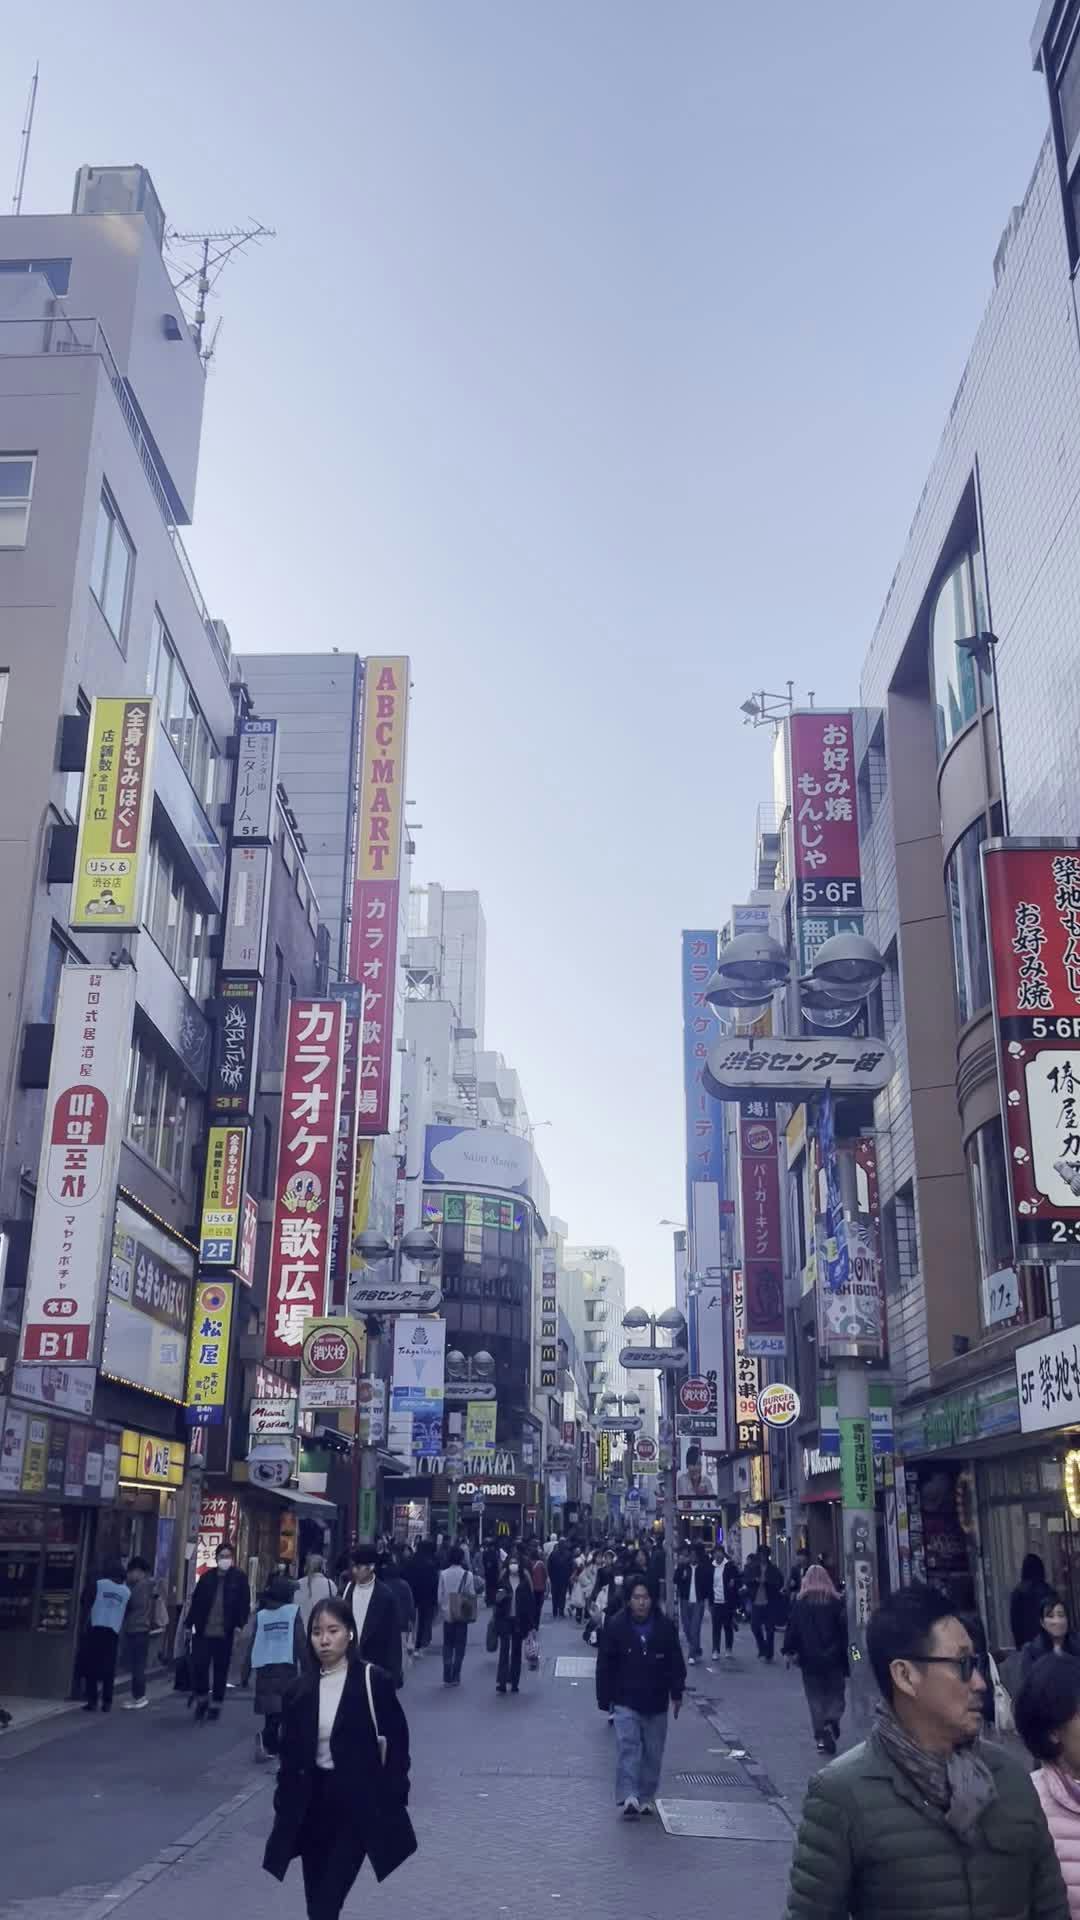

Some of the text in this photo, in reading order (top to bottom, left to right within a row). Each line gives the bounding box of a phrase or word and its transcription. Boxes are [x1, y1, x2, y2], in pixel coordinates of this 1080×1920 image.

[94, 729, 116, 821] 店舗数全国1位
[116, 706, 146, 848] 全身もみほぐし
[238, 735, 257, 823] モニタールーム
[823, 723, 853, 822] お好み焼
[242, 826, 259, 836] 5F
[797, 773, 827, 869] もんじゃ
[90, 861, 127, 873] りらくる
[92, 876, 122, 889] 渋谷店
[1012, 901, 1053, 1011] お好み焼
[359, 898, 386, 1114] カラオケ歌広場
[79, 974, 102, 1078] 韓国式居酒屋
[719, 1050, 884, 1074] 渋谷センター街
[287, 1003, 334, 1167] カラオケ
[60, 1092, 96, 1199] 마약포차
[752, 1164, 769, 1254] バーガーキング
[205, 1241, 231, 1258] 2F
[274, 1217, 321, 1349] 歌広場
[353, 1289, 437, 1302] 渋谷センター街
[39, 1330, 75, 1358] B1
[198, 1317, 224, 1366] 松屋
[313, 1344, 346, 1361] 消火栓
[763, 1392, 794, 1406] BURGER
[1021, 1369, 1036, 1406] 5F
[252, 1407, 286, 1418] Miami
[764, 1401, 796, 1417] KING
[200, 1498, 228, 1511] ラオケ
[448, 1482, 516, 1497] cDnald's
